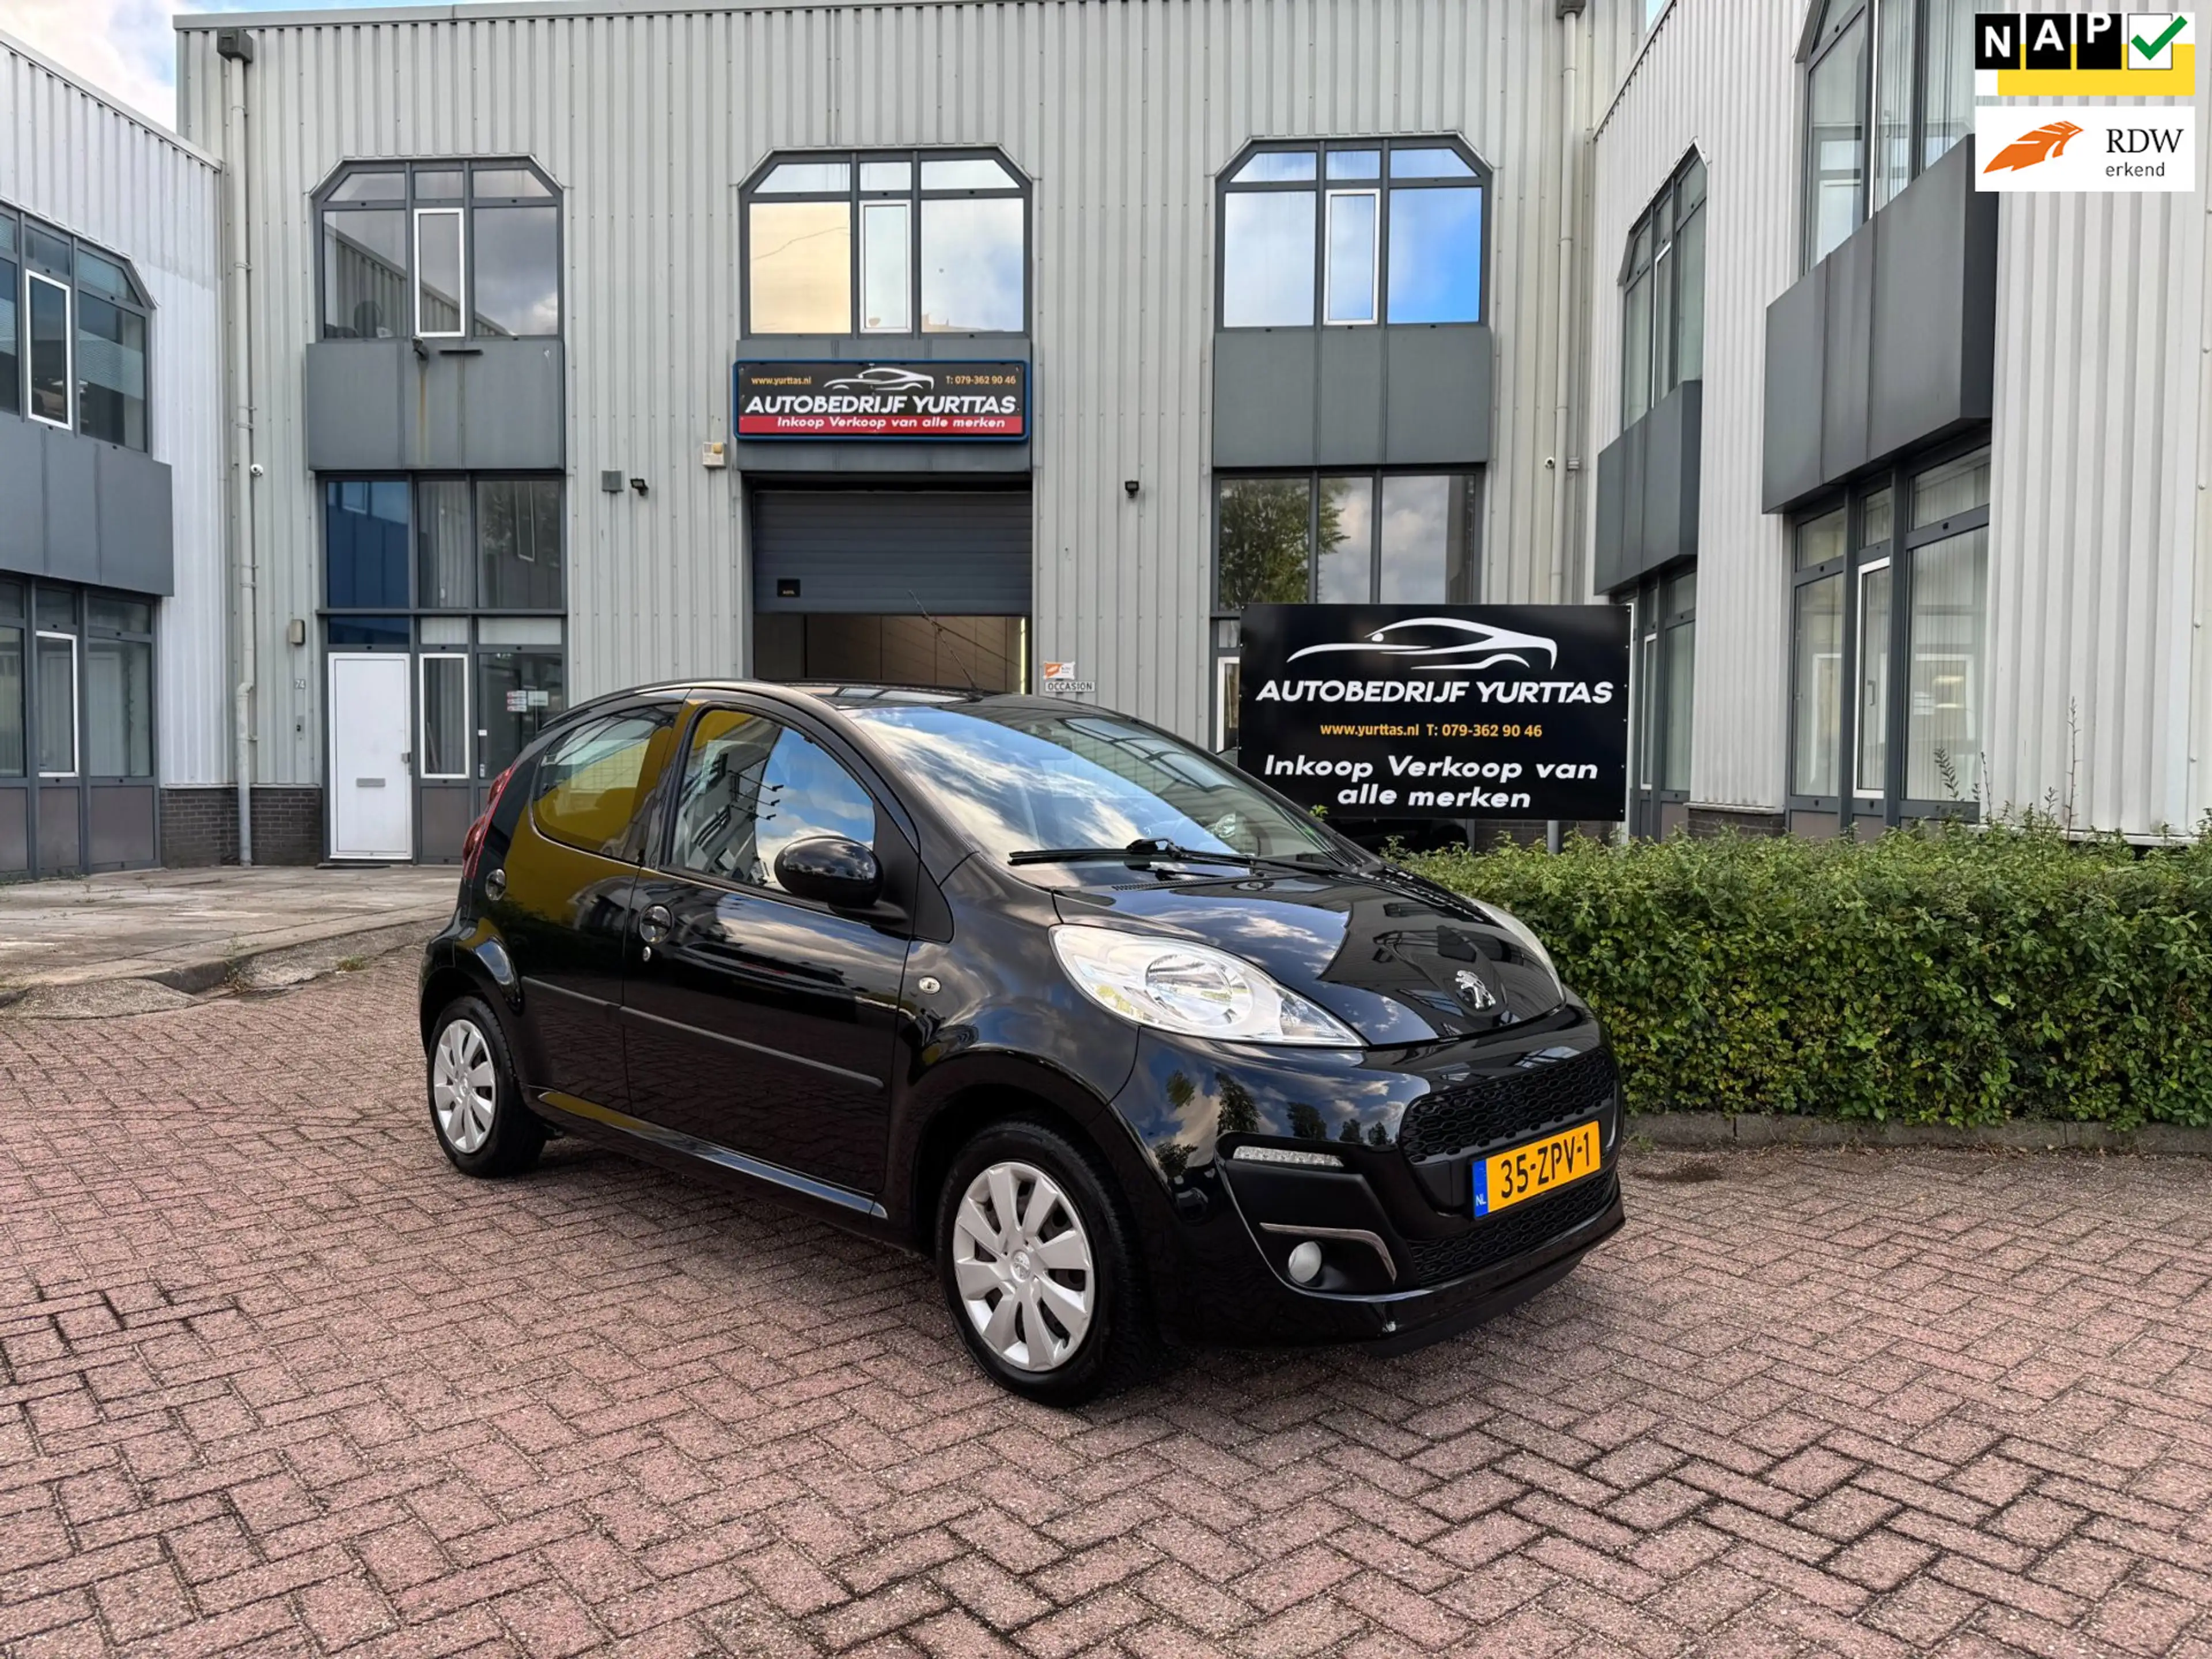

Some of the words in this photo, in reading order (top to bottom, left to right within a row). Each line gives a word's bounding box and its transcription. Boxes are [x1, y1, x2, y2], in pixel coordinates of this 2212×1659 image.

[751, 376, 812, 385] www.yurttas.nl
[946, 376, 953, 384] T:
[955, 376, 990, 384] 079-362
[991, 376, 1003, 384] 90
[1005, 376, 1016, 385] 46
[745, 396, 907, 414] AUTOBEDRIJF
[912, 396, 1017, 414] YURTTAS
[778, 416, 825, 429] Inkoop
[830, 416, 887, 429] Verkoop
[892, 419, 917, 427] van
[922, 417, 948, 427] alle
[953, 417, 1005, 428] merken
[1048, 682, 1092, 691] OCCASION
[1256, 680, 1469, 703] AUTOBEDRIJF
[1477, 681, 1613, 704] YURTTAS
[1320, 724, 1419, 737] www.yurttas.nl
[1426, 724, 1438, 736] T:
[1442, 724, 1498, 737] 079-362
[1502, 725, 1520, 737] 90
[1524, 725, 1542, 737] 46
[1265, 755, 1373, 782] Inkoop
[1388, 756, 1522, 783] Verkoop
[1536, 763, 1598, 779] van
[1338, 783, 1397, 805] alle
[1408, 786, 1531, 808] merken
[1501, 1132, 1590, 1199] 35-ZPV-1
[1475, 1193, 1487, 1206] NL
